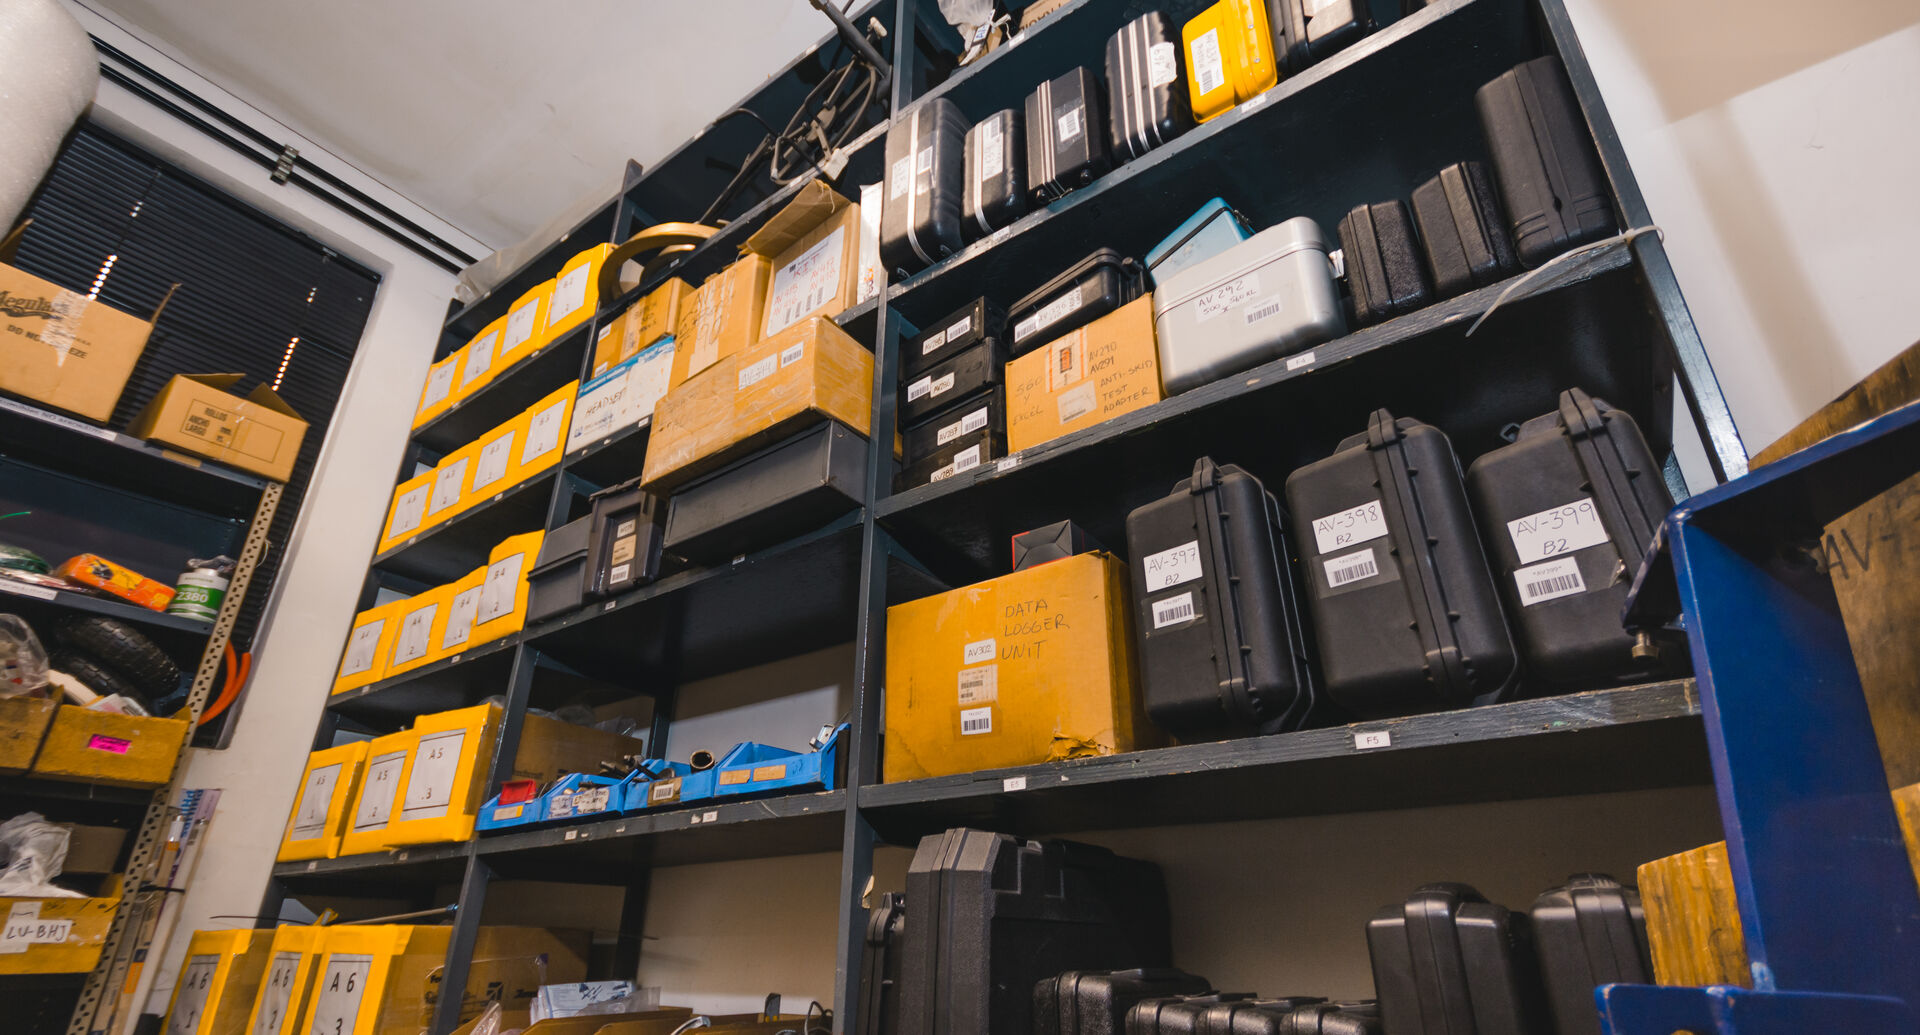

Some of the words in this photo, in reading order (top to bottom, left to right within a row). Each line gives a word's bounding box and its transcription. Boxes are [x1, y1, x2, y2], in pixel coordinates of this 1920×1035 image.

[1090, 356, 1115, 374] AV291
[1102, 384, 1127, 401] TEST
[1103, 387, 1154, 413] ADAPTER
[1318, 505, 1378, 535] AV-398
[1517, 503, 1596, 537] AV-399
[1336, 532, 1353, 545] B2
[1543, 538, 1569, 555] B2
[1149, 547, 1196, 574] AV-397
[1165, 573, 1180, 585] B2
[176, 591, 209, 604] 2380
[1004, 599, 1048, 618] DATA
[1004, 613, 1071, 637] LOGGER
[1001, 640, 1047, 660] UNIT
[1366, 736, 1380, 744] F5
